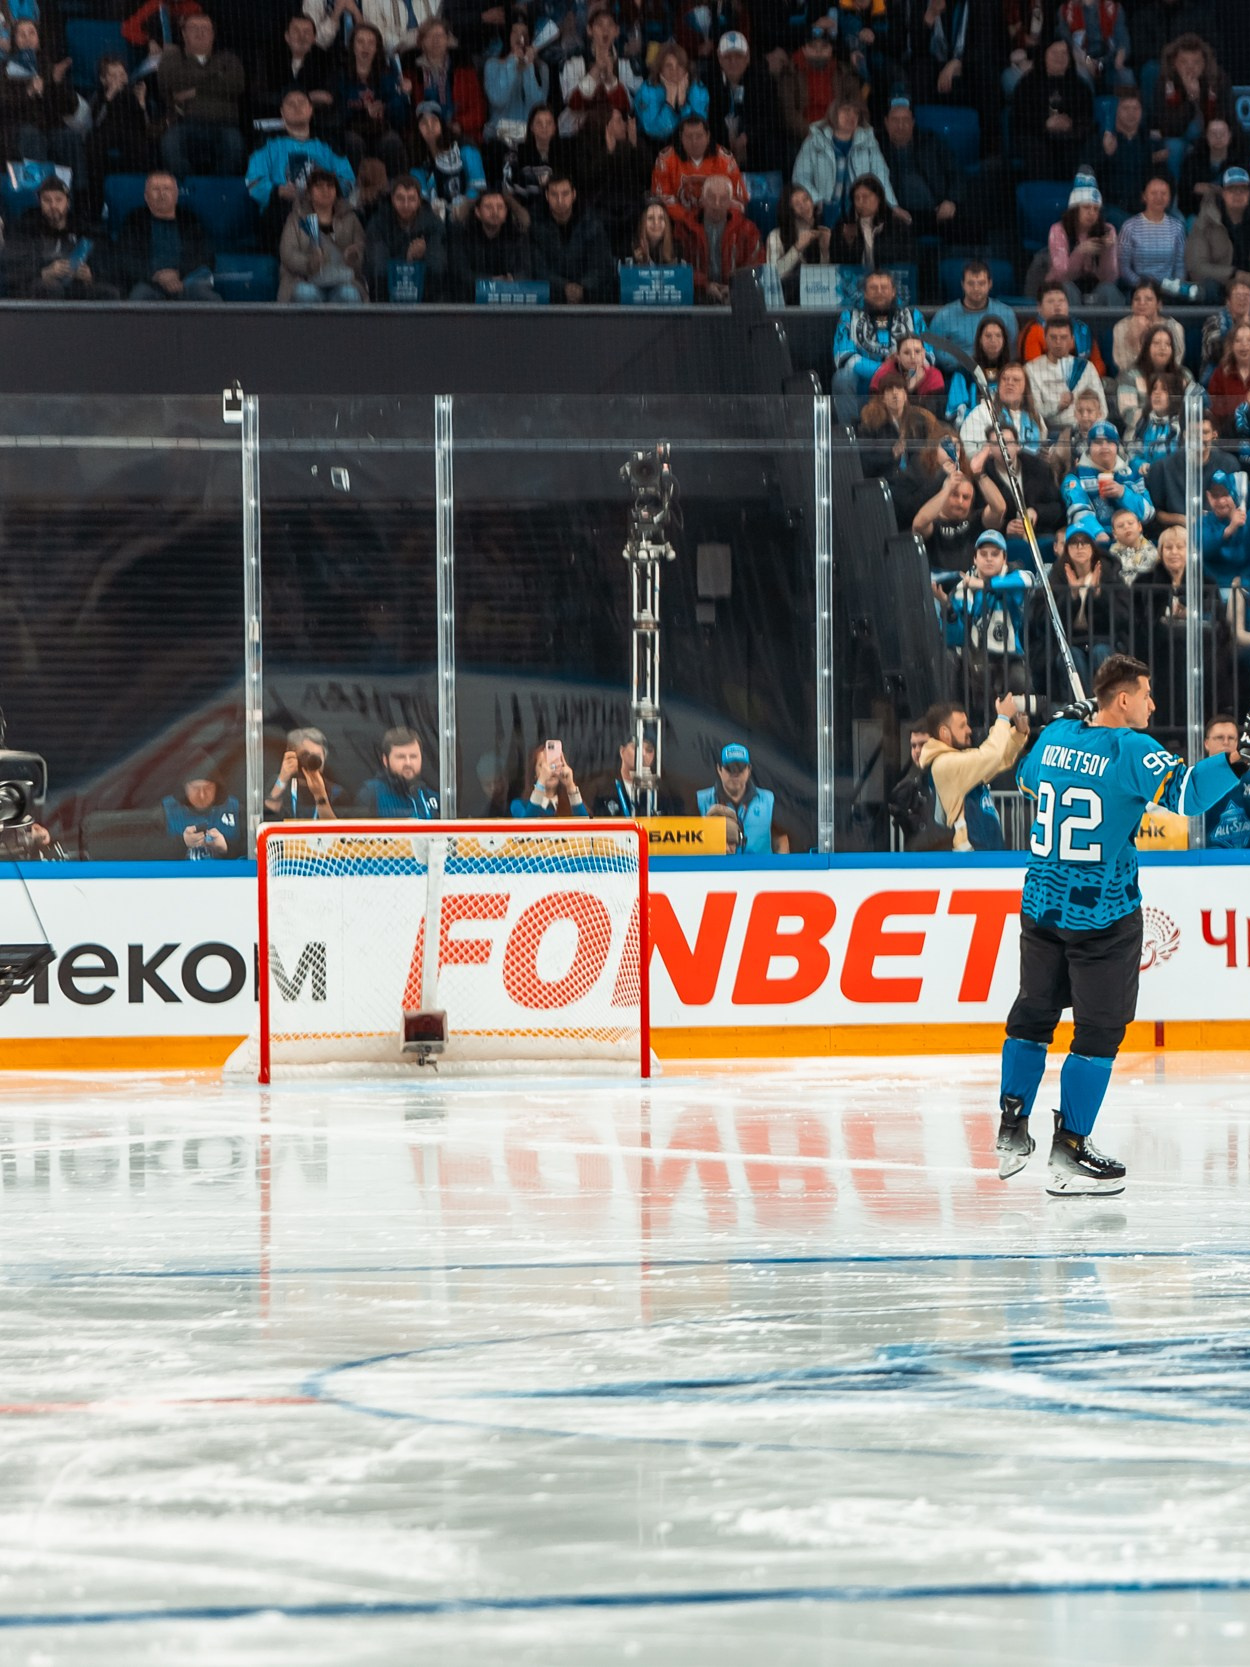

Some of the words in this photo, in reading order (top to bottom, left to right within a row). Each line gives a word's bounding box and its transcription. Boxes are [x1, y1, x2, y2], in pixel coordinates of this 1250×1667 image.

[1041, 745, 1110, 777] KUZNETSOV
[1142, 751, 1178, 776] 92
[1030, 781, 1103, 862] 92
[1138, 825, 1166, 838] НК
[649, 830, 704, 844] БАНК
[403, 889, 1021, 1009] FONBET
